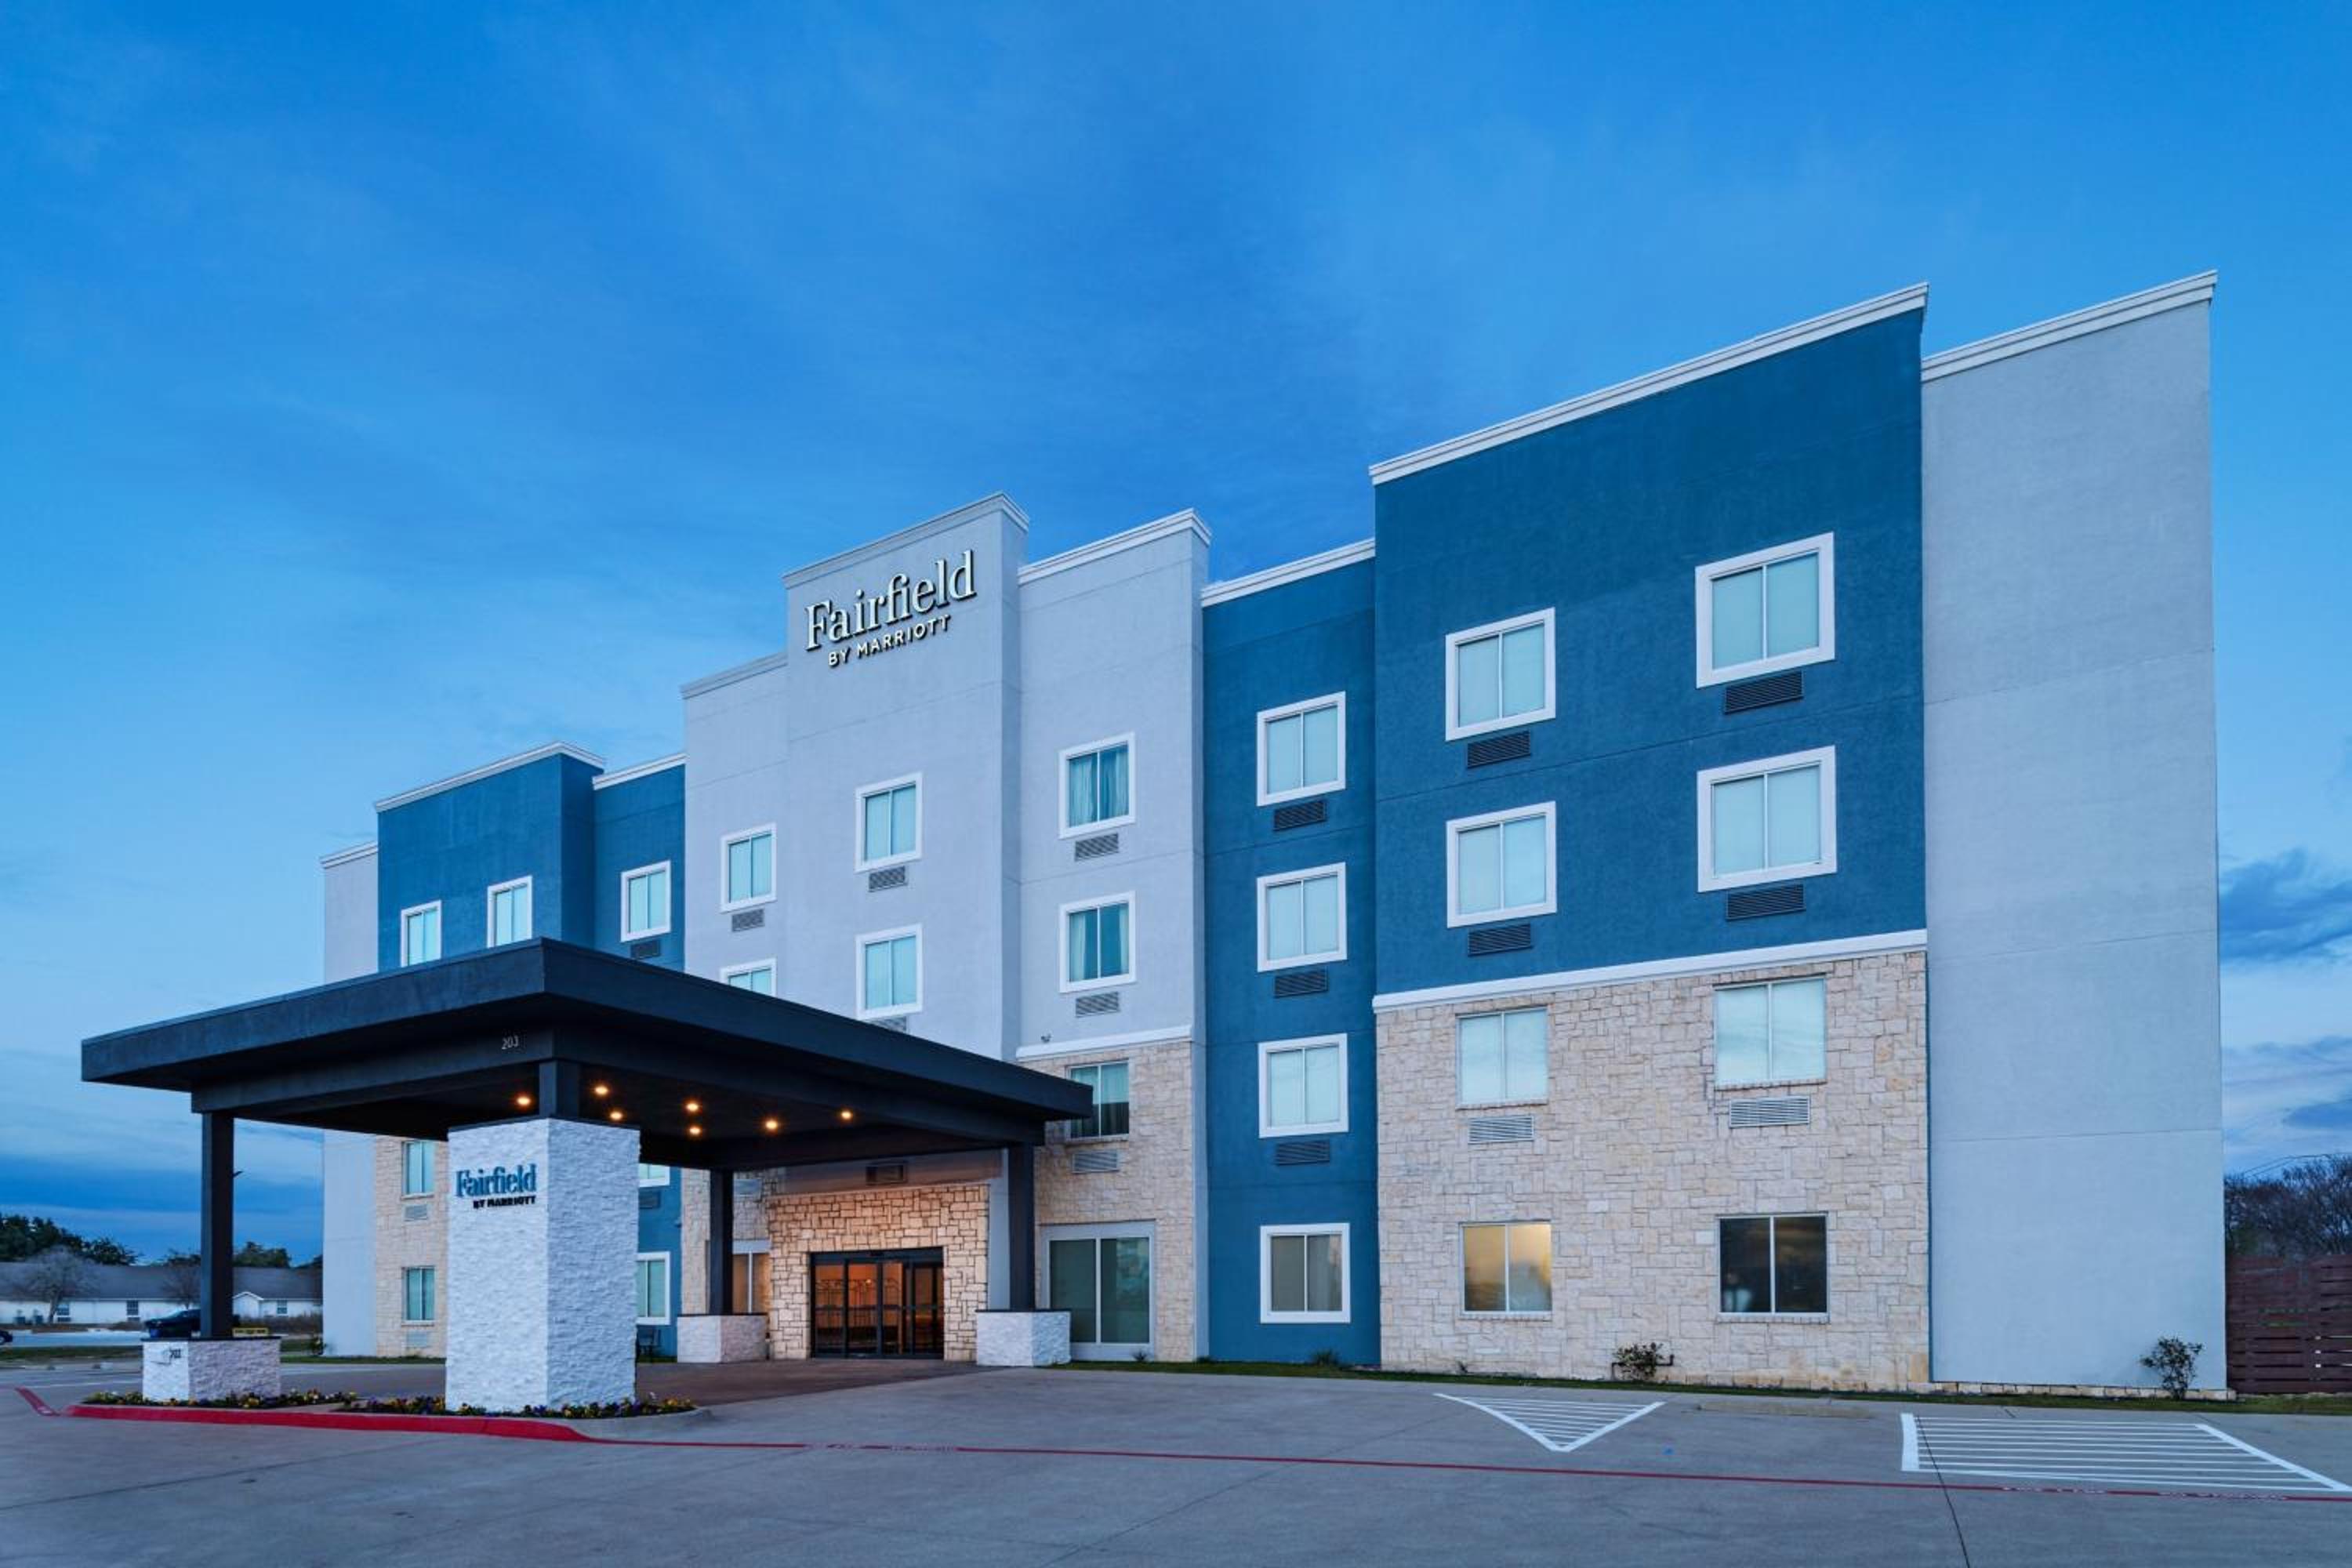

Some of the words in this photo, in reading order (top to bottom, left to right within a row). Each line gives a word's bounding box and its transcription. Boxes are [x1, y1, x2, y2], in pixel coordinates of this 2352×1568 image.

[804, 550, 977, 652] Fairfield
[829, 648, 851, 668] BY
[858, 615, 951, 659] MARRIOTT
[456, 1163, 536, 1198] Fairfield
[473, 1200, 485, 1209] BY
[487, 1196, 536, 1207] MARRIOTT
